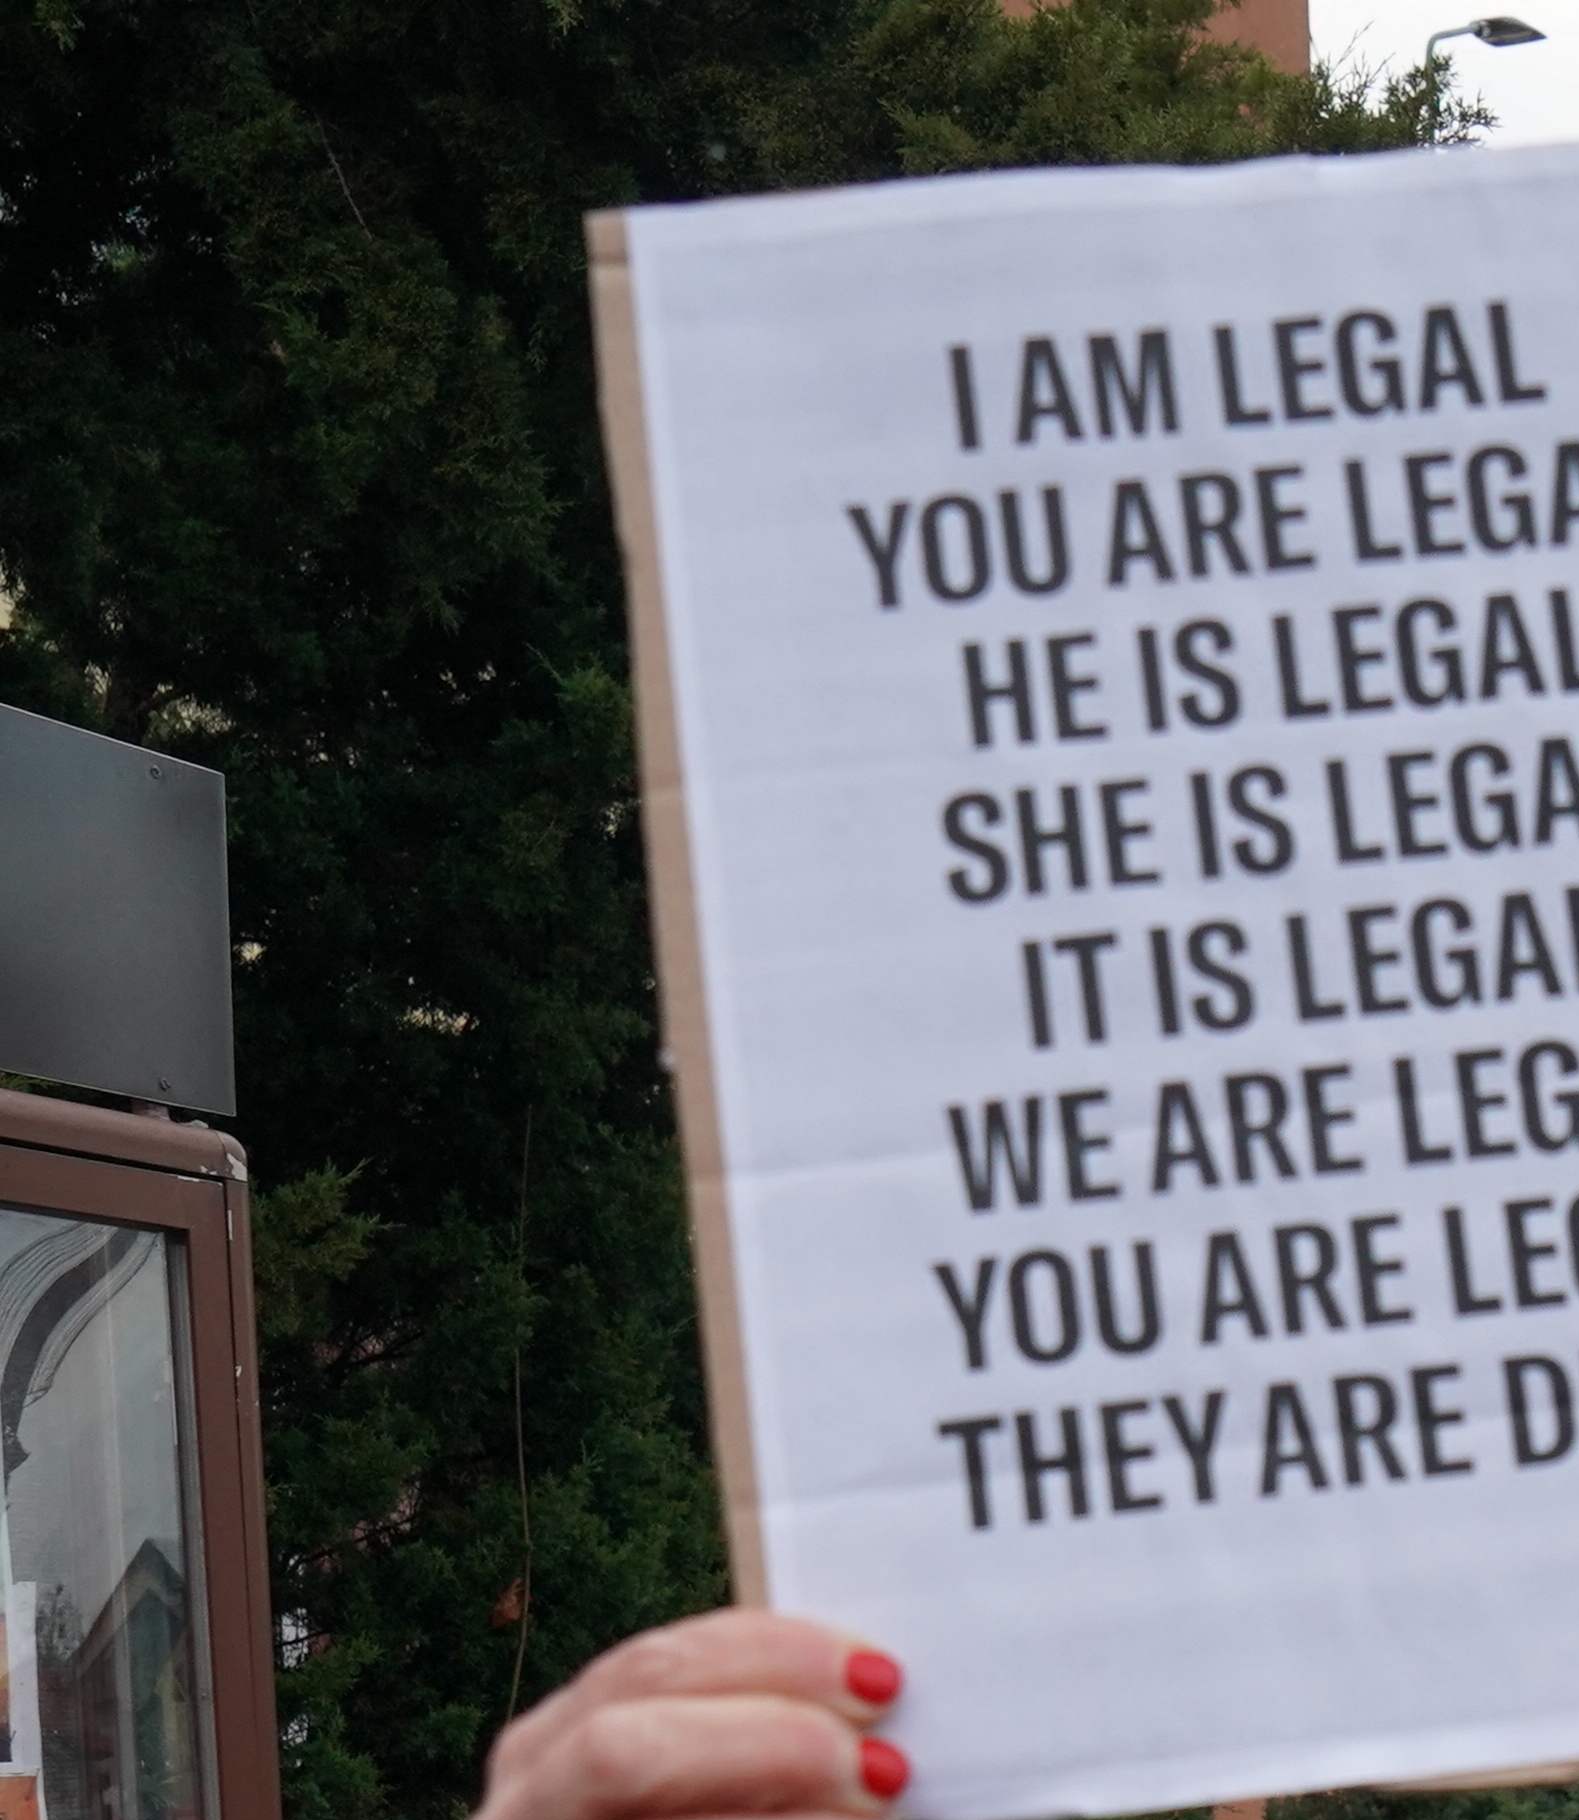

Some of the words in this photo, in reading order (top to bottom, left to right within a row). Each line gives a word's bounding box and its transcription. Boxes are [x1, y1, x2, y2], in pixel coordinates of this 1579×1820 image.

[948, 344, 981, 453] I
[1015, 328, 1181, 446] AM
[1212, 300, 1548, 428] LEGAL
[846, 484, 1072, 610] YOU
[1106, 464, 1317, 588] ARE
[962, 631, 1108, 750] HE
[1136, 618, 1242, 734] IS
[941, 778, 1162, 906] SHE
[1189, 764, 1295, 880] IS
[1021, 931, 1119, 1050] IT
[1148, 920, 1256, 1038] IS
[946, 1088, 1122, 1214] WE
[1151, 1062, 1365, 1195] ARE
[932, 1240, 1164, 1372] YOU
[1200, 1212, 1414, 1346] ARE
[937, 1389, 1226, 1532] THEY
[1259, 1363, 1474, 1498] ARE
